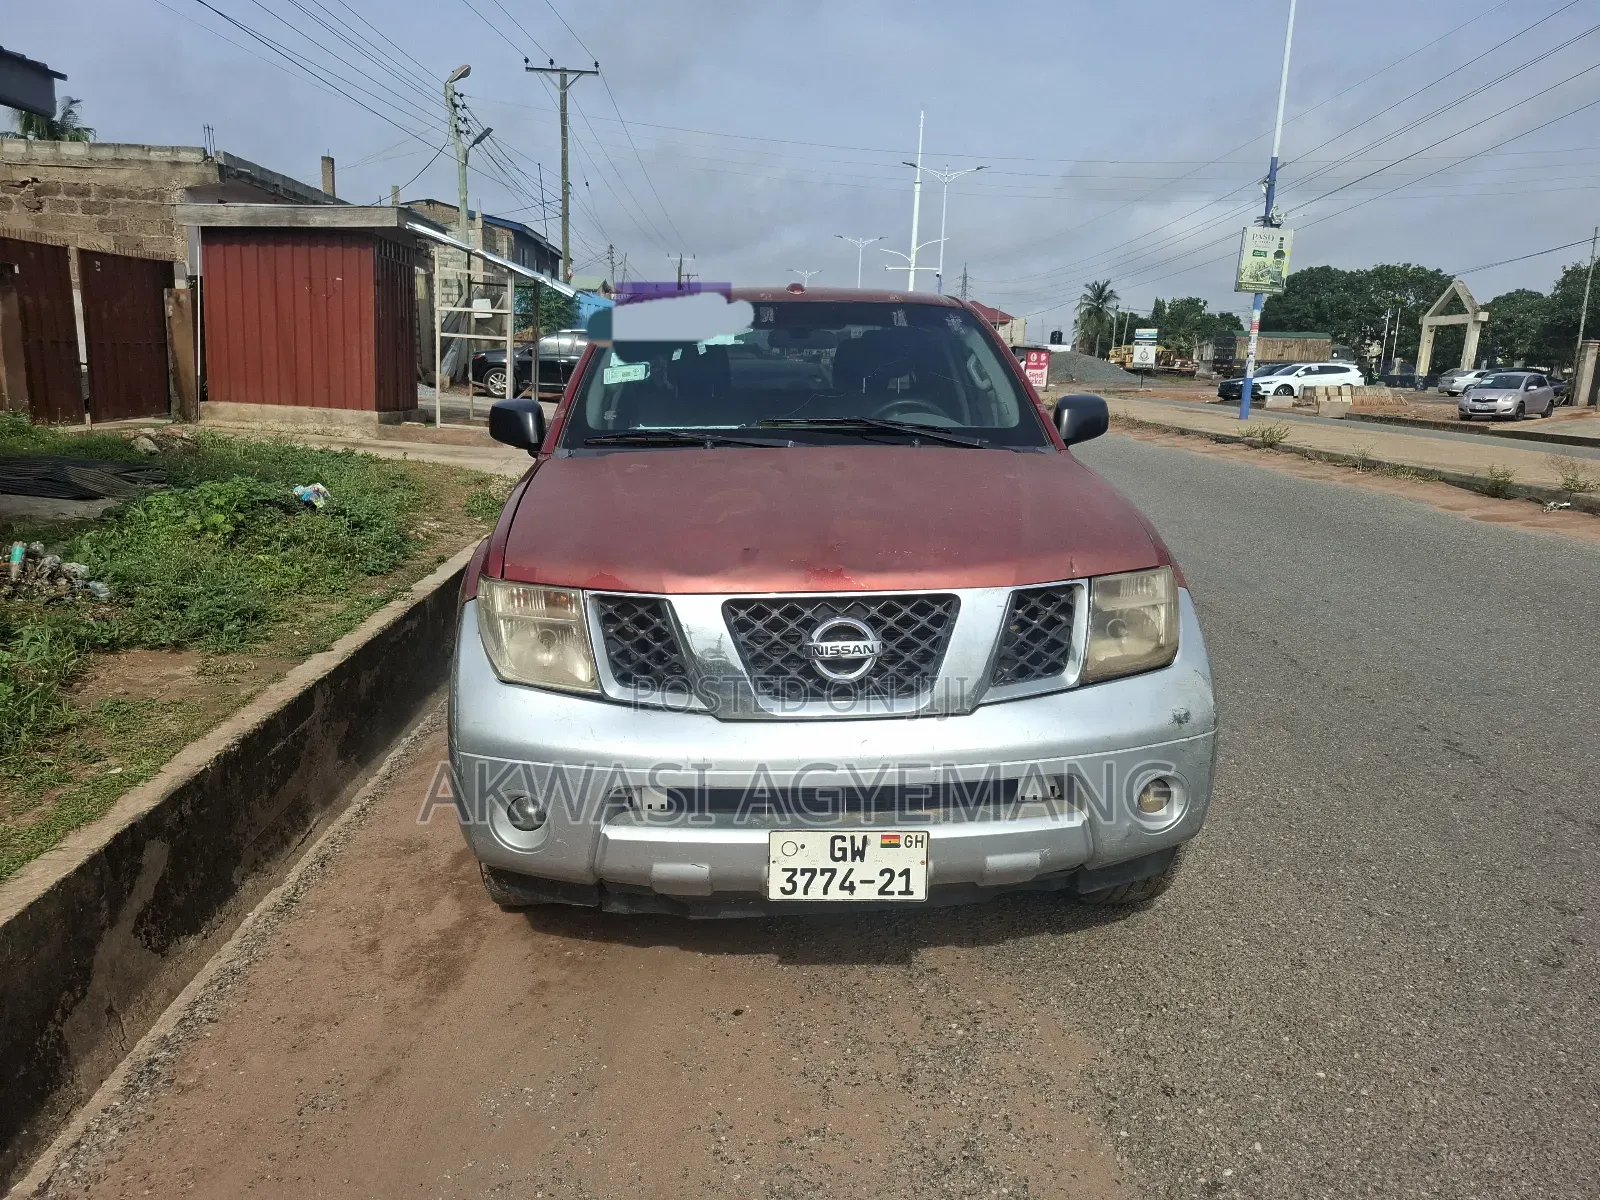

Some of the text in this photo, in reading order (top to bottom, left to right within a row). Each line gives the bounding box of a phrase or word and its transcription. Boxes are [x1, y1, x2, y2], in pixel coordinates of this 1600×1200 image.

[811, 644, 875, 656] NISSAN
[829, 834, 868, 863] GW
[903, 834, 925, 849] GH
[779, 867, 914, 896] 3774-21
